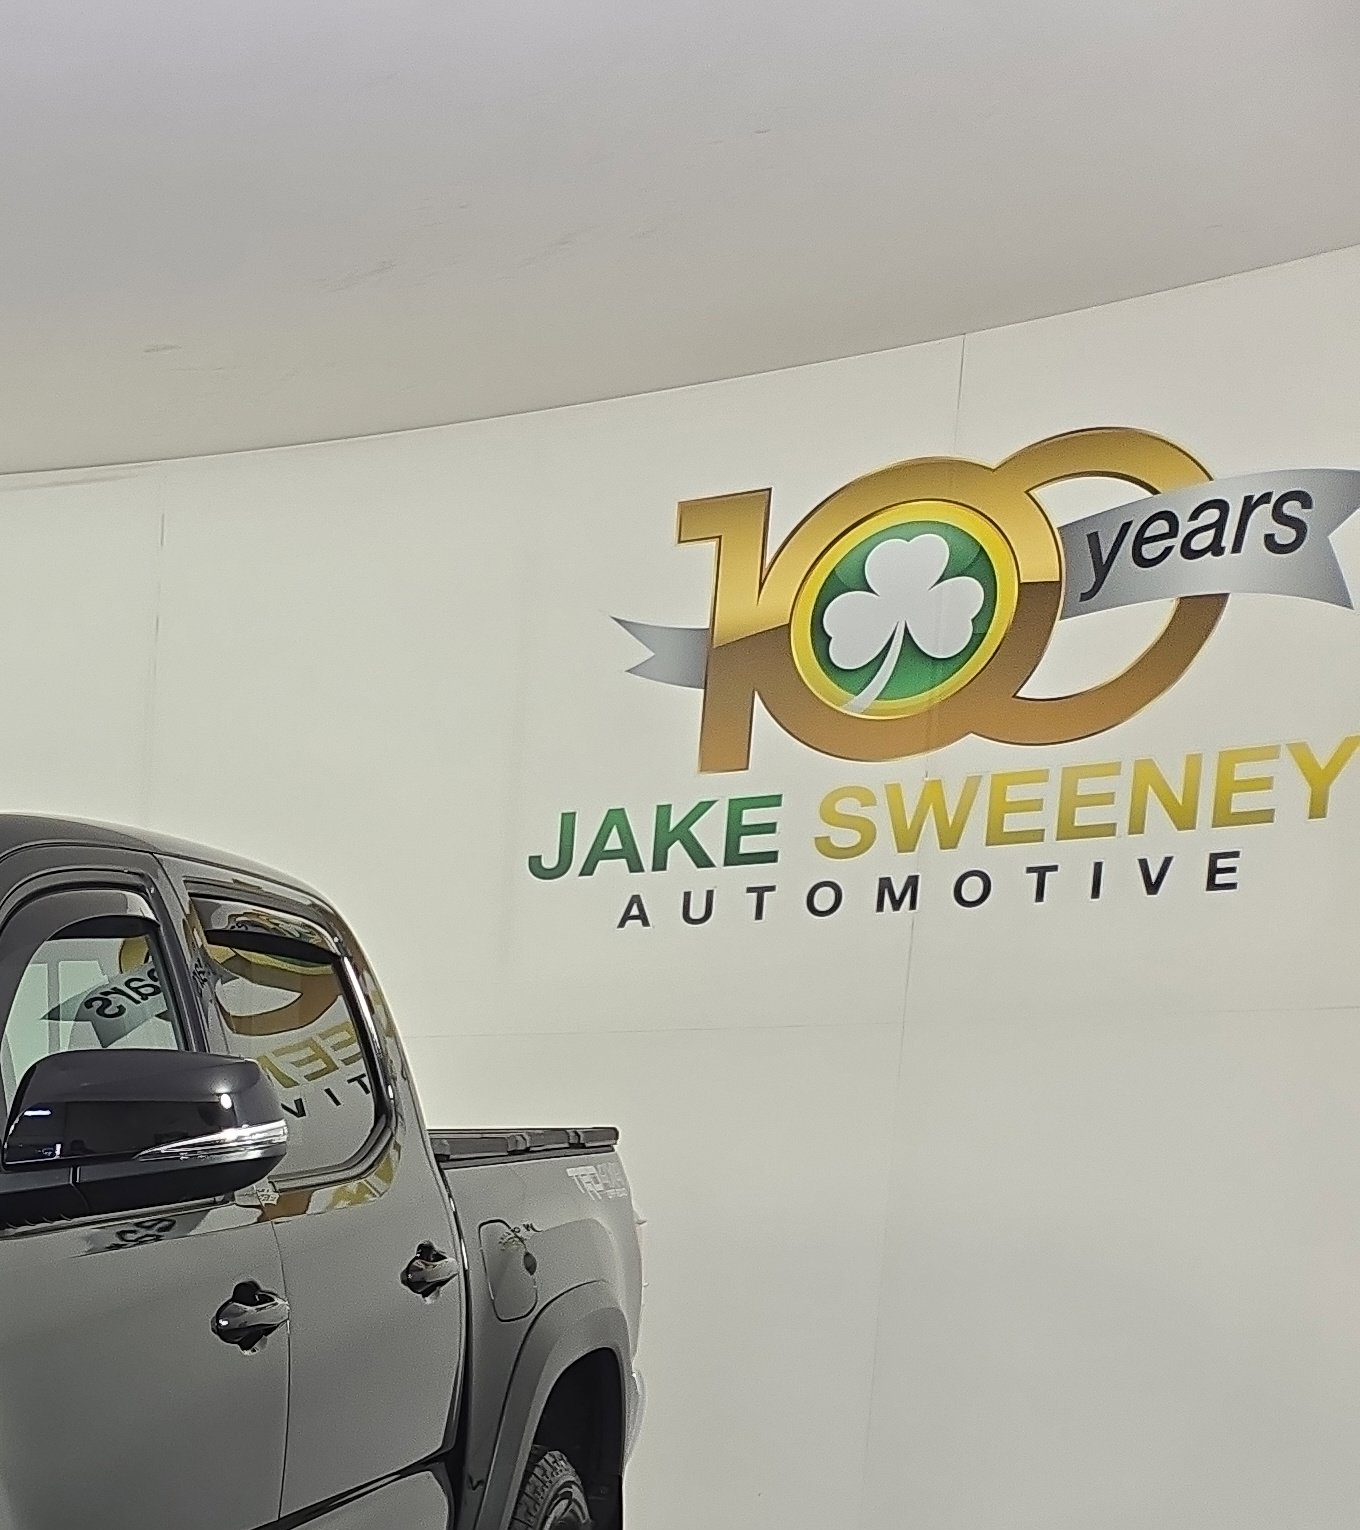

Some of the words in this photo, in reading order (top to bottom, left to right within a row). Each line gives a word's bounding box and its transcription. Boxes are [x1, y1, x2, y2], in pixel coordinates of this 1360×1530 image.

[1079, 486, 1314, 600] years
[527, 794, 784, 881] JAKE
[813, 735, 1360, 861] SWEENEY
[616, 850, 1243, 930] AUTOMOTIVE
